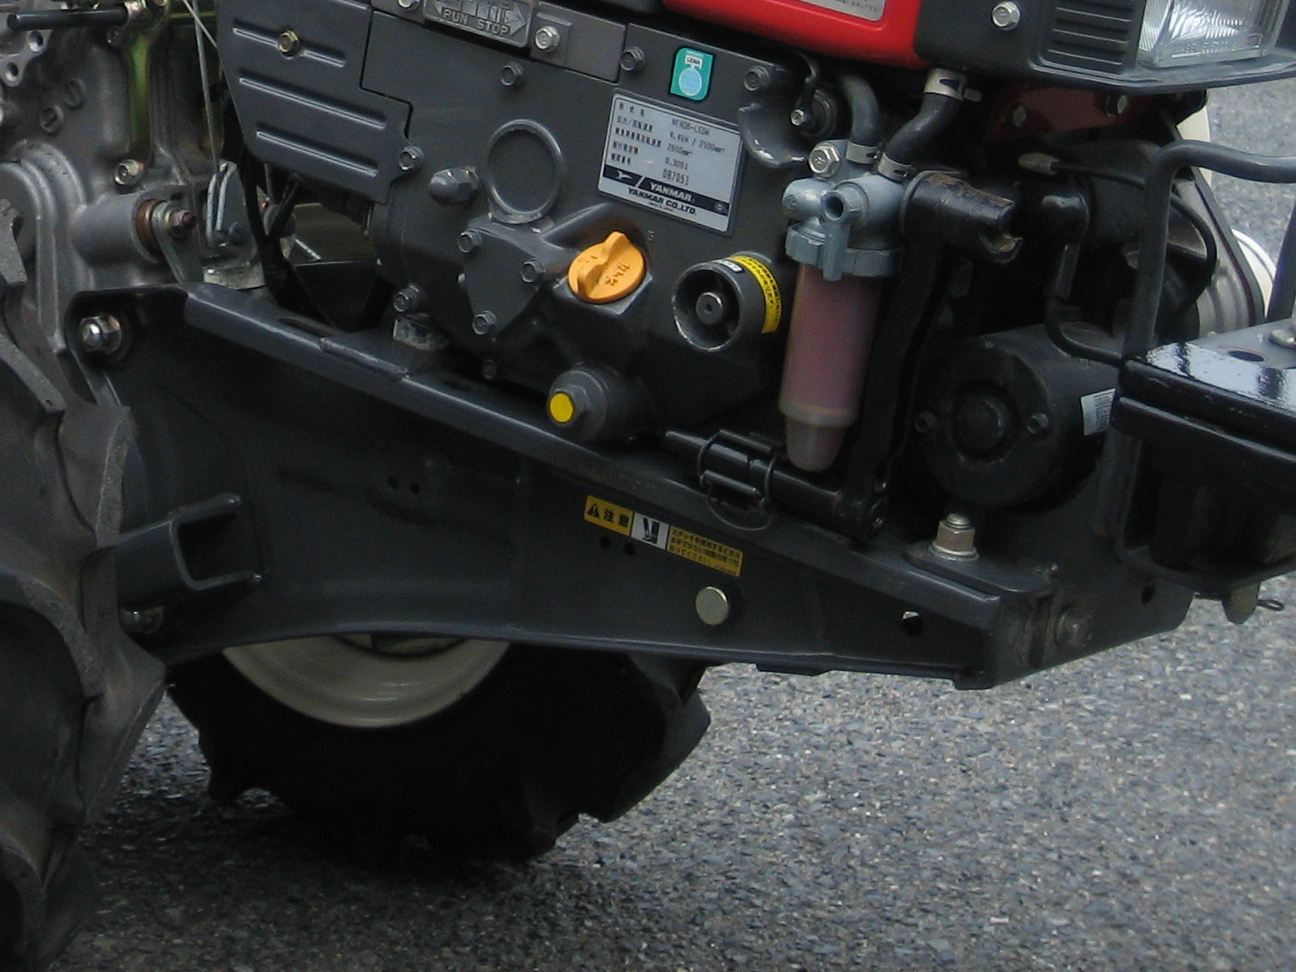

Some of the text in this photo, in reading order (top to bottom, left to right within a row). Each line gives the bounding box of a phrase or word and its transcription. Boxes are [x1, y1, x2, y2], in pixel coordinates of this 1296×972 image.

[442, 5, 510, 36] RUN STOP
[627, 186, 664, 205] YANMAR
[649, 181, 693, 203] YANMAR
[603, 508, 631, 528] 注意
